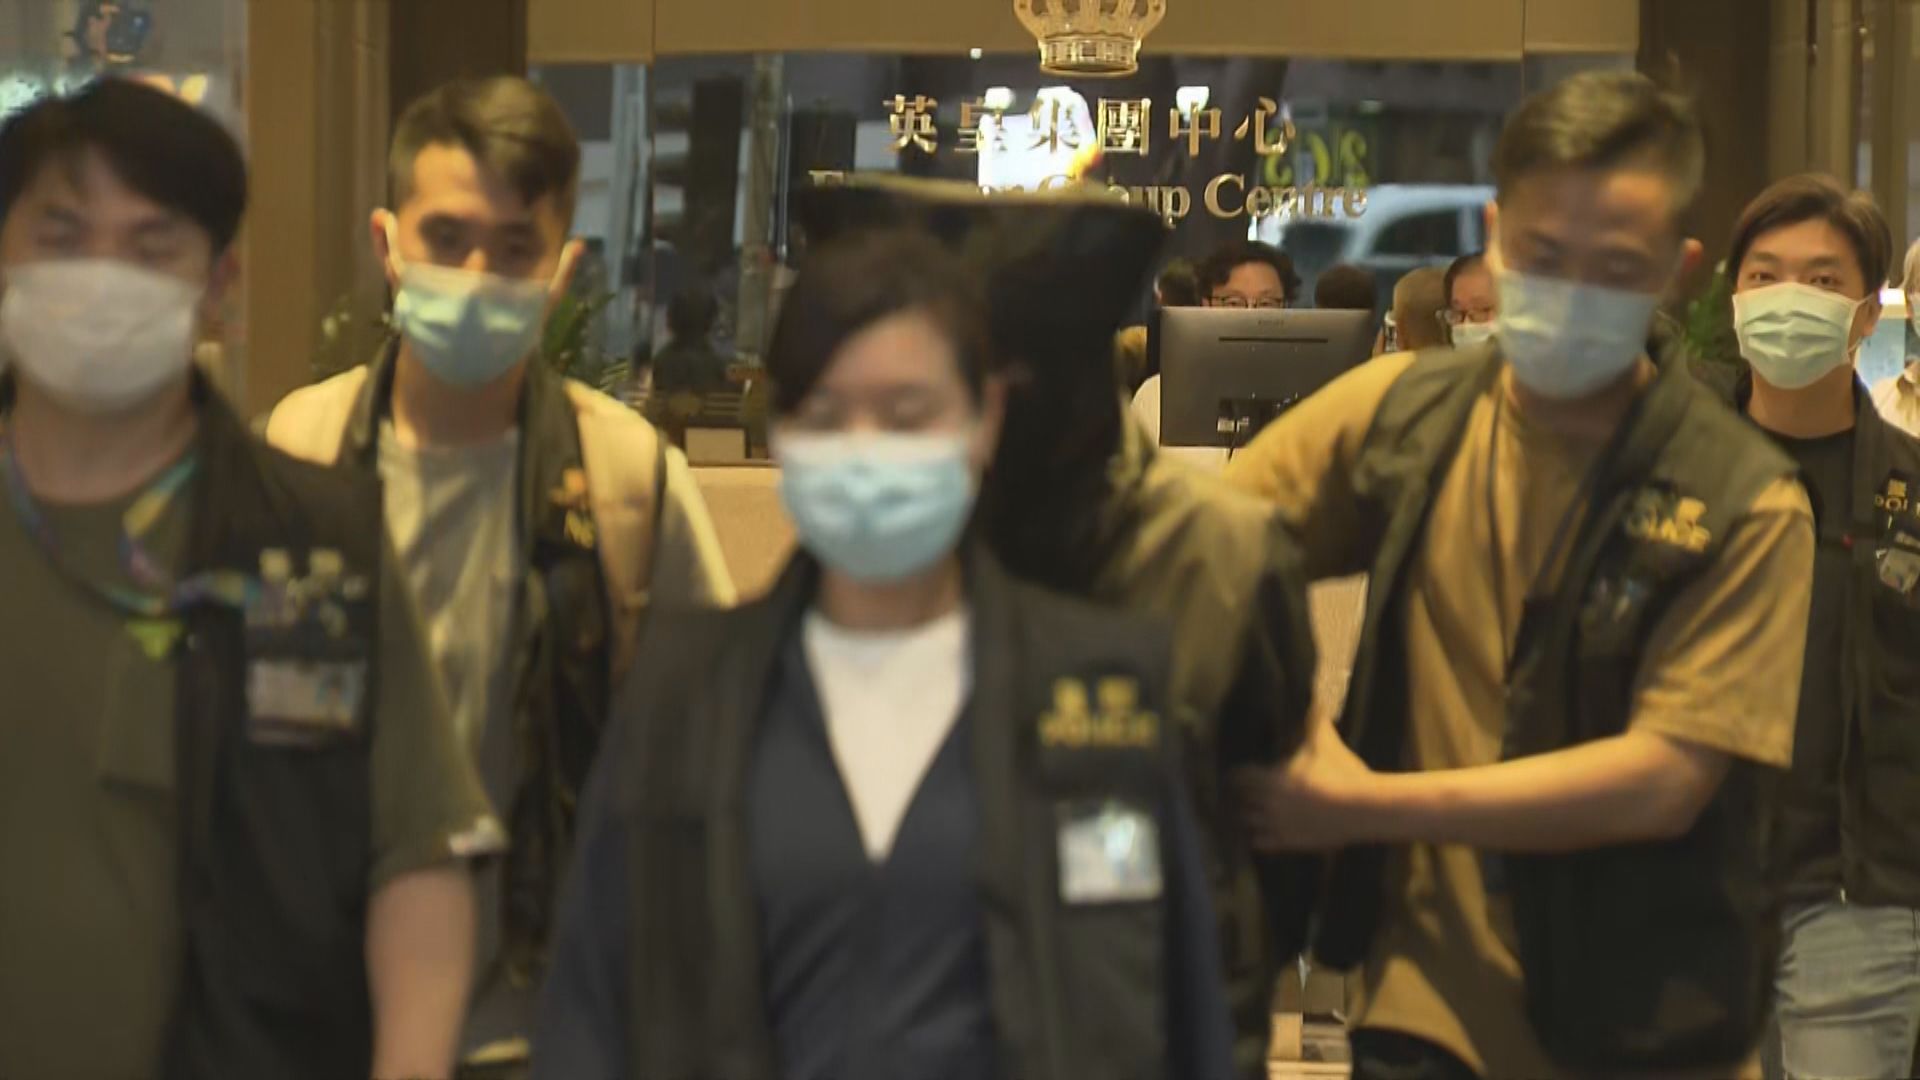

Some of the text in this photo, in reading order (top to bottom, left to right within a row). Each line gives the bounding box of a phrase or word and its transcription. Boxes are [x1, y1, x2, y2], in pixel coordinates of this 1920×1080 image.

[883, 94, 1297, 157] 英皇集團中心
[1203, 172, 1368, 219] Centre
